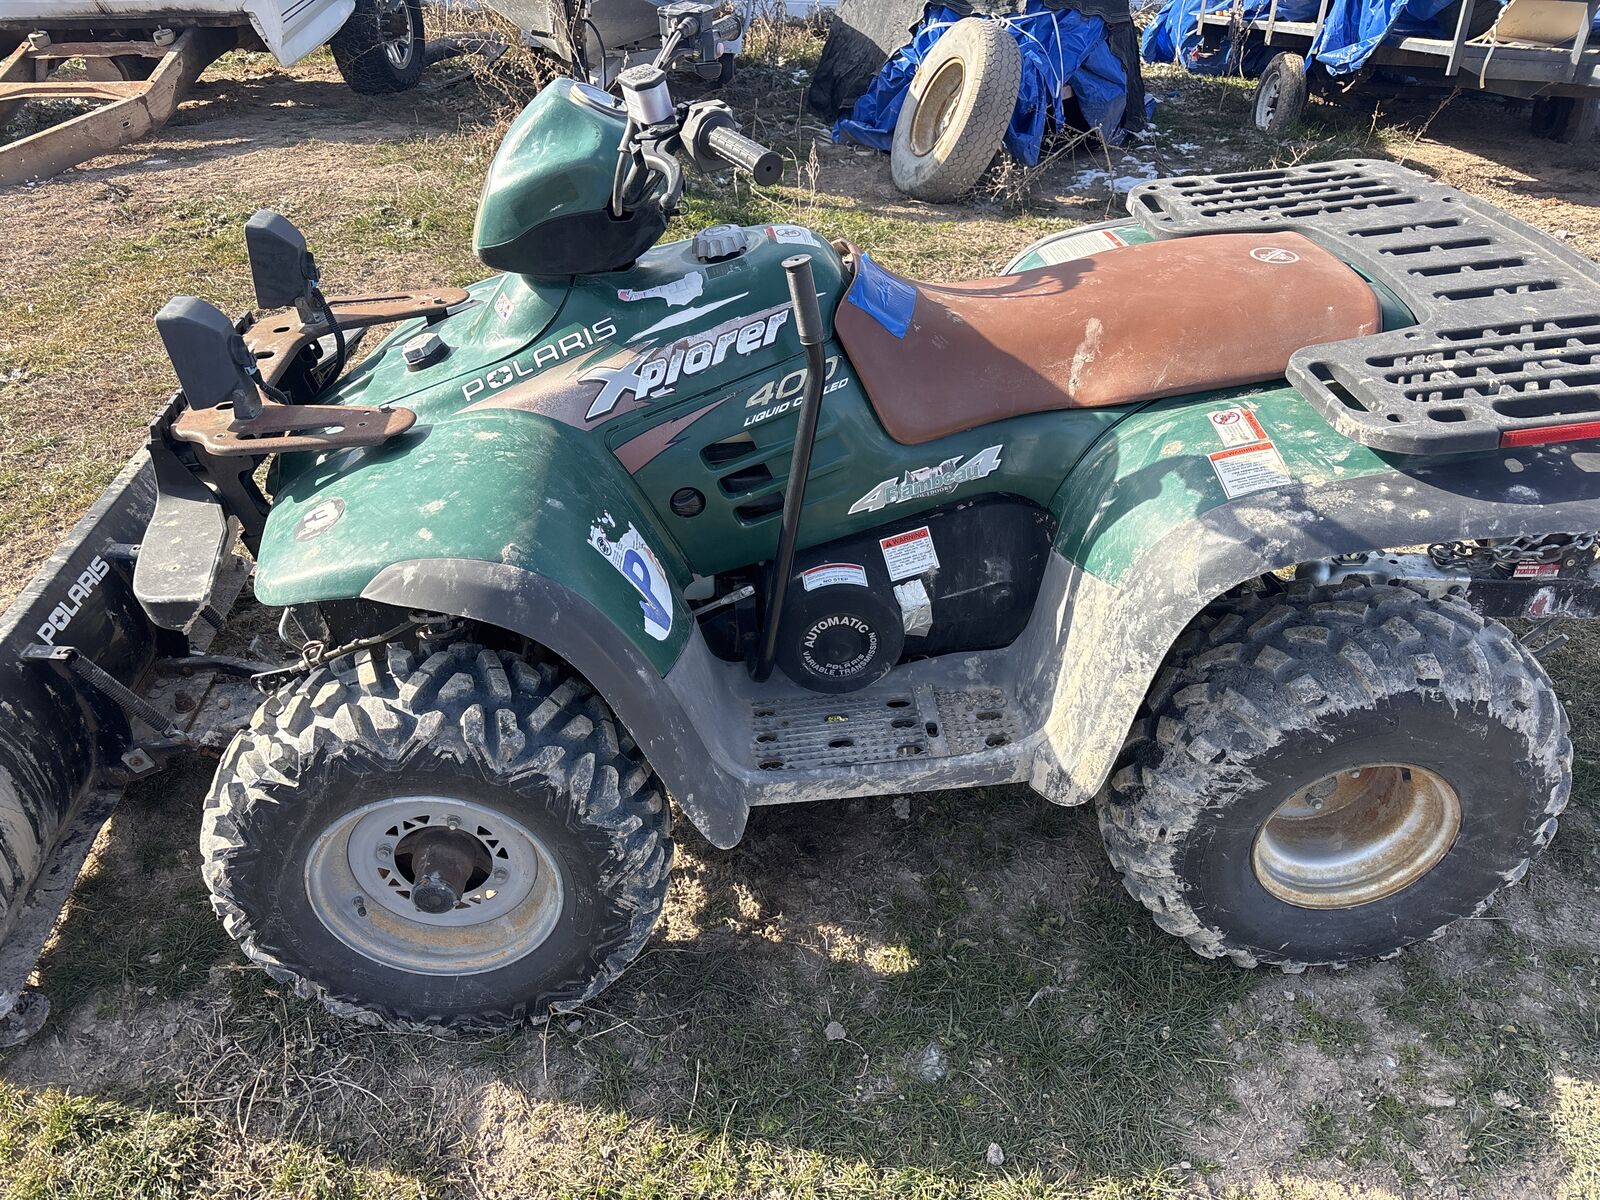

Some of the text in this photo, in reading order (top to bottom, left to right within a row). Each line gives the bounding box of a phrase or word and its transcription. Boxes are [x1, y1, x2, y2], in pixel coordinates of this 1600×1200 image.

[461, 317, 617, 401] POLARIS
[577, 309, 789, 420] Xplorer
[743, 378, 849, 427] LIQUID CLED
[884, 464, 981, 504] Flambeau
[917, 485, 953, 498] OUTDOORS
[893, 530, 927, 545] WARNING
[36, 554, 110, 646] POLARIS
[804, 616, 868, 648] AUTOMATIC
[803, 632, 878, 677] VARIABLE TRANSMISSION
[826, 653, 865, 669] POLARIS
